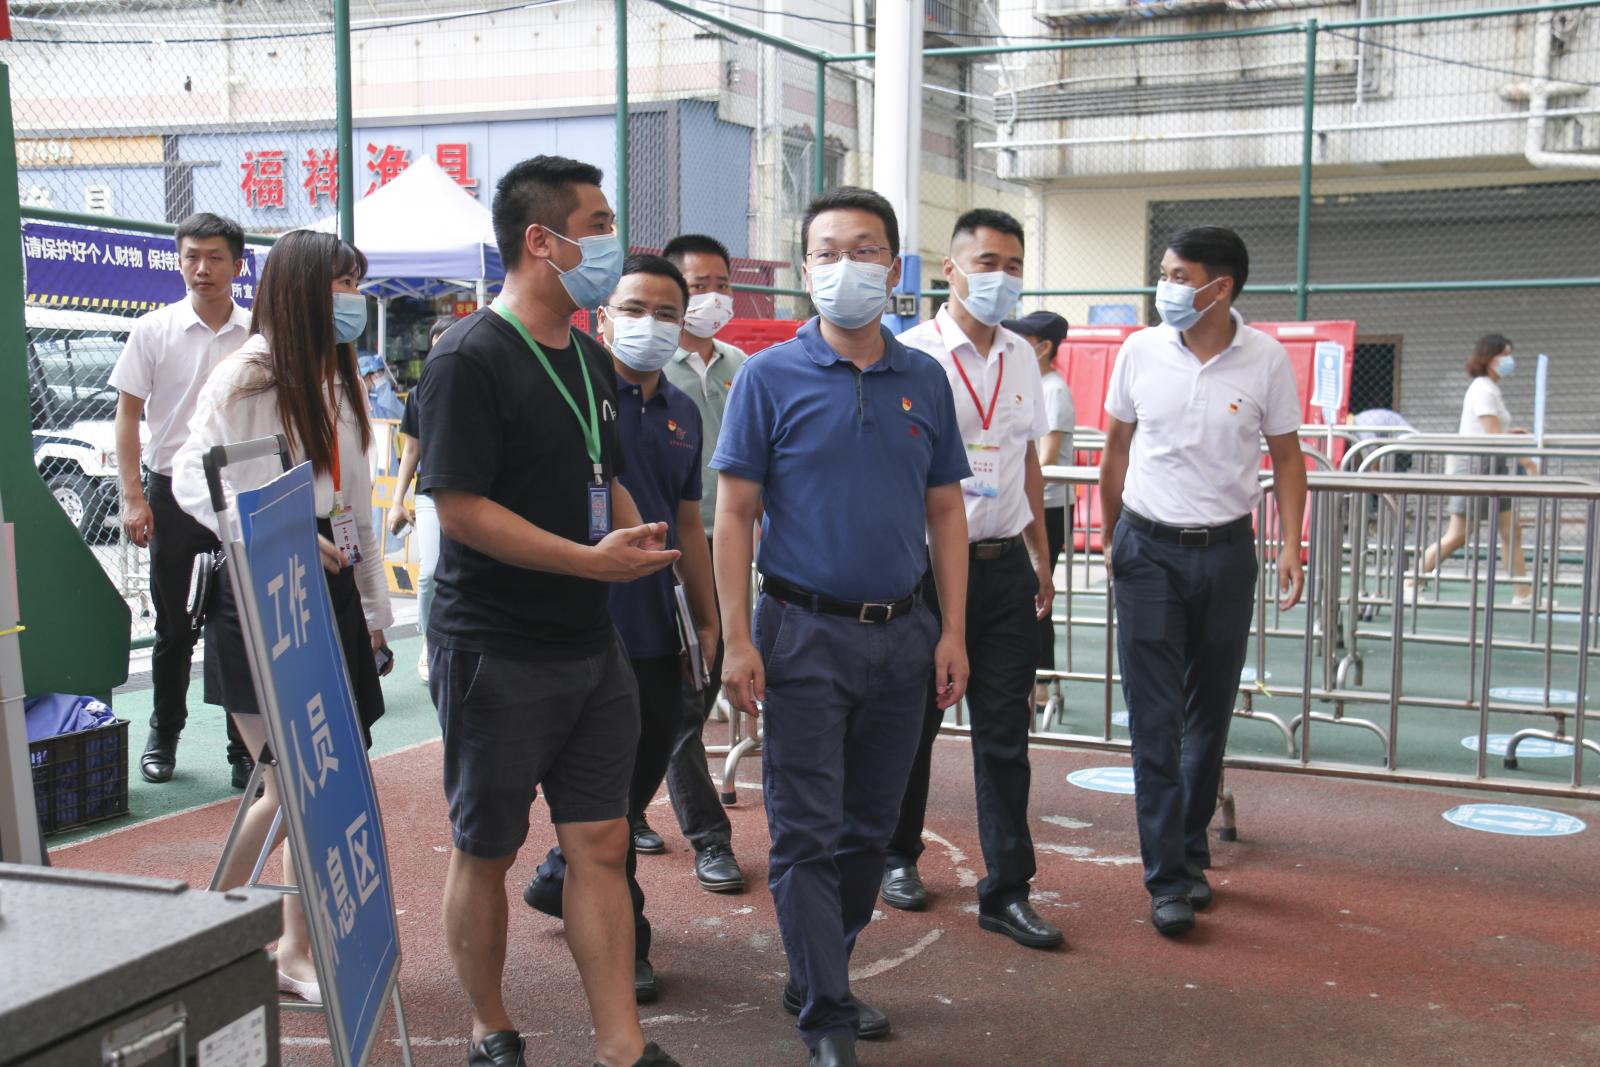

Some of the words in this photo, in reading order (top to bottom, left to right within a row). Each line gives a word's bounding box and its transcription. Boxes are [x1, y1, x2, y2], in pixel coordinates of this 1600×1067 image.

[240, 142, 478, 208] 福祥渔具
[25, 236, 143, 268] 请保护好个人财物
[267, 553, 311, 661] 工作
[289, 692, 340, 817] 人员
